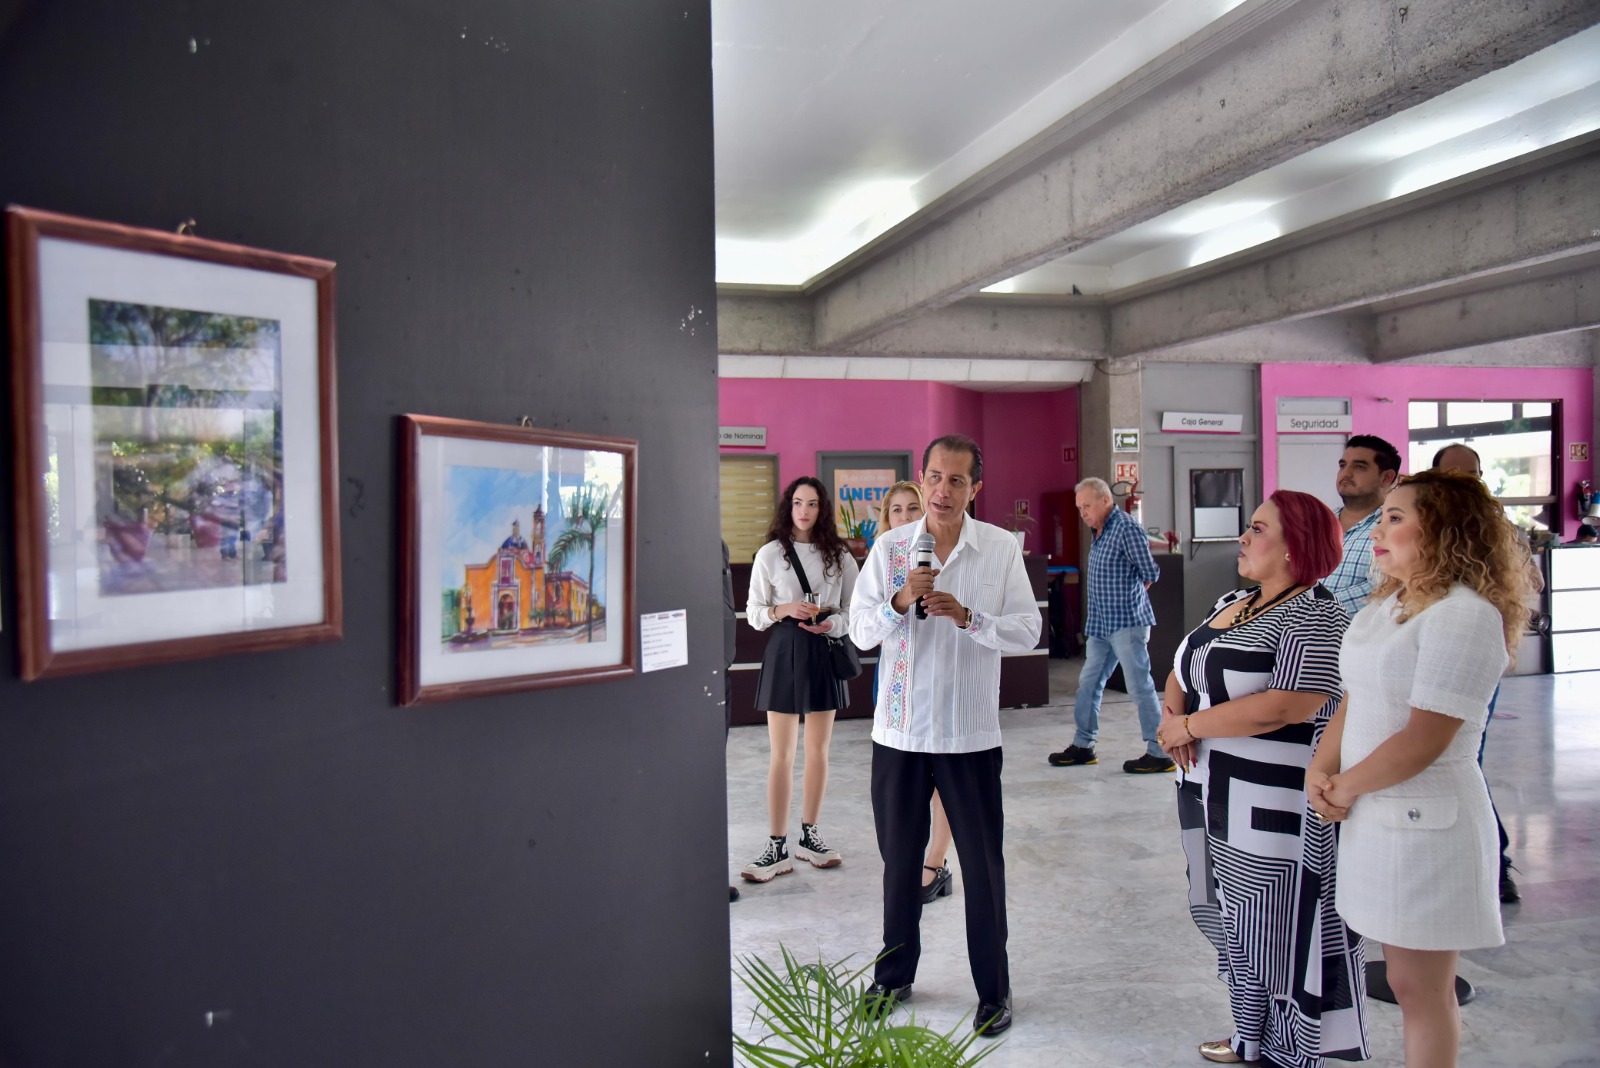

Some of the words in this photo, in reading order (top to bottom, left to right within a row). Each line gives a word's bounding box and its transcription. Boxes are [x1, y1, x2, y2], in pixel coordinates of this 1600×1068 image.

[1181, 417, 1197, 427] Caja
[1198, 418, 1224, 426] General
[1290, 418, 1339, 430] Seguridad
[723, 432, 733, 440] de
